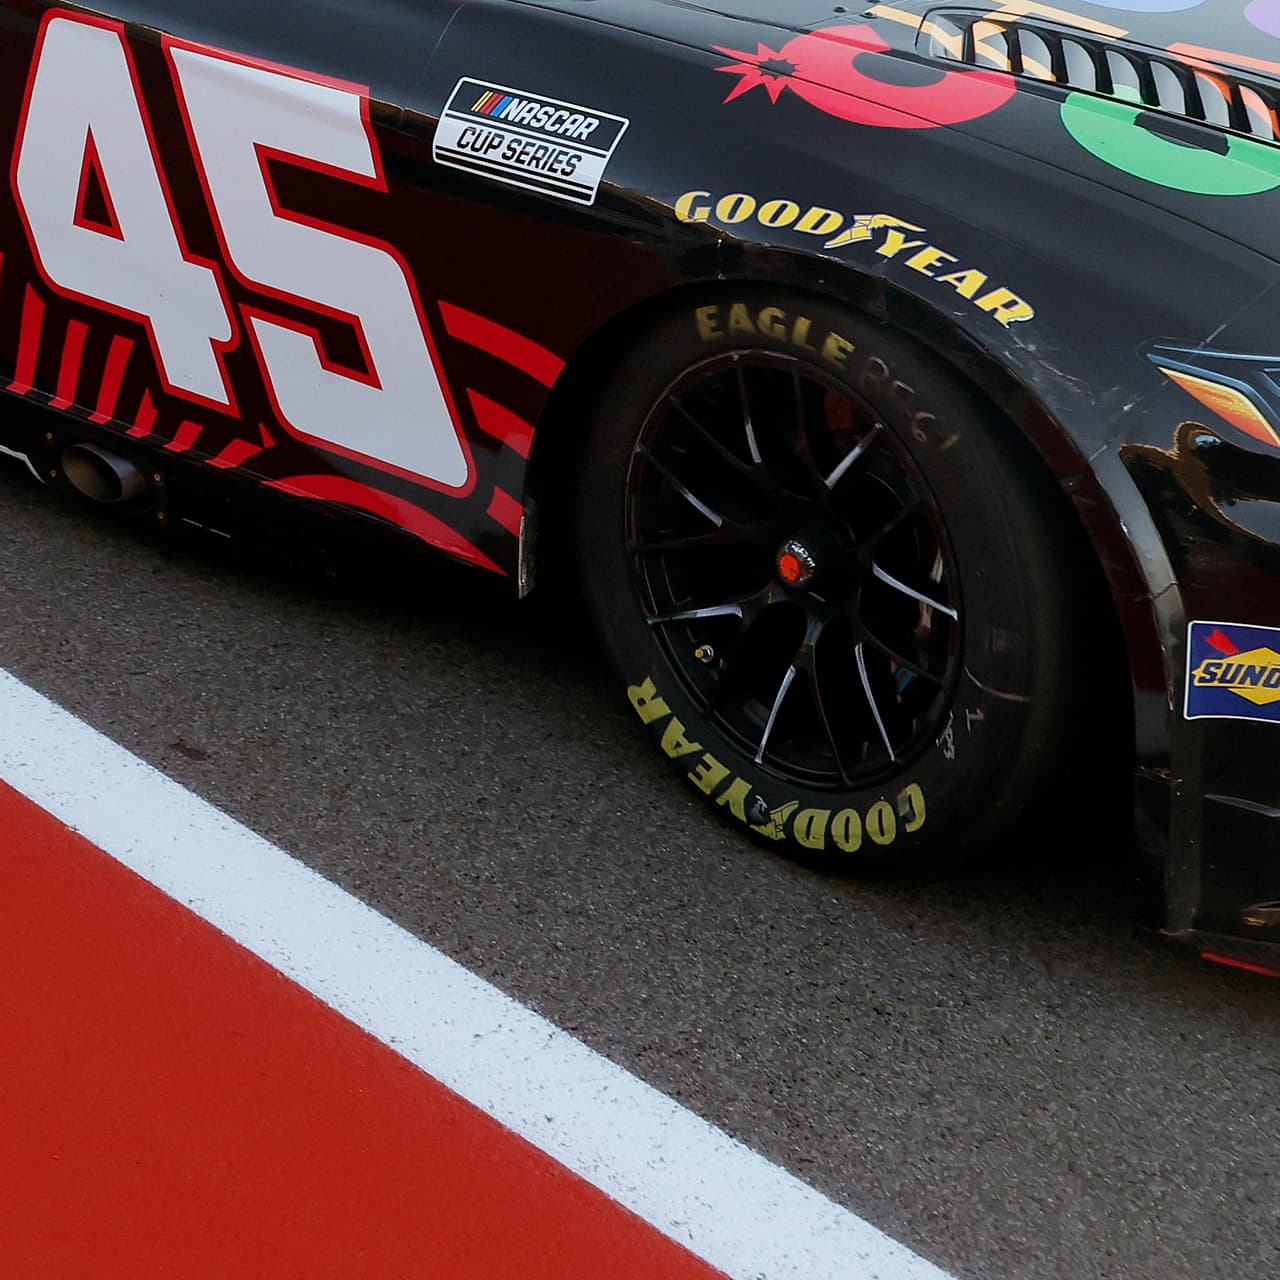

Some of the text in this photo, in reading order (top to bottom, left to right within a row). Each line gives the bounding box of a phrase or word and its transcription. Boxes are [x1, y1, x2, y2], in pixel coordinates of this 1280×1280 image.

[456, 126, 583, 178] CUP SERIES
[499, 97, 600, 141] NASCAR
[11, 9, 477, 497] 45
[673, 190, 1037, 329] GOODYEAR
[695, 303, 857, 372] EAGLE
[627, 676, 927, 853] GOODYEAR
